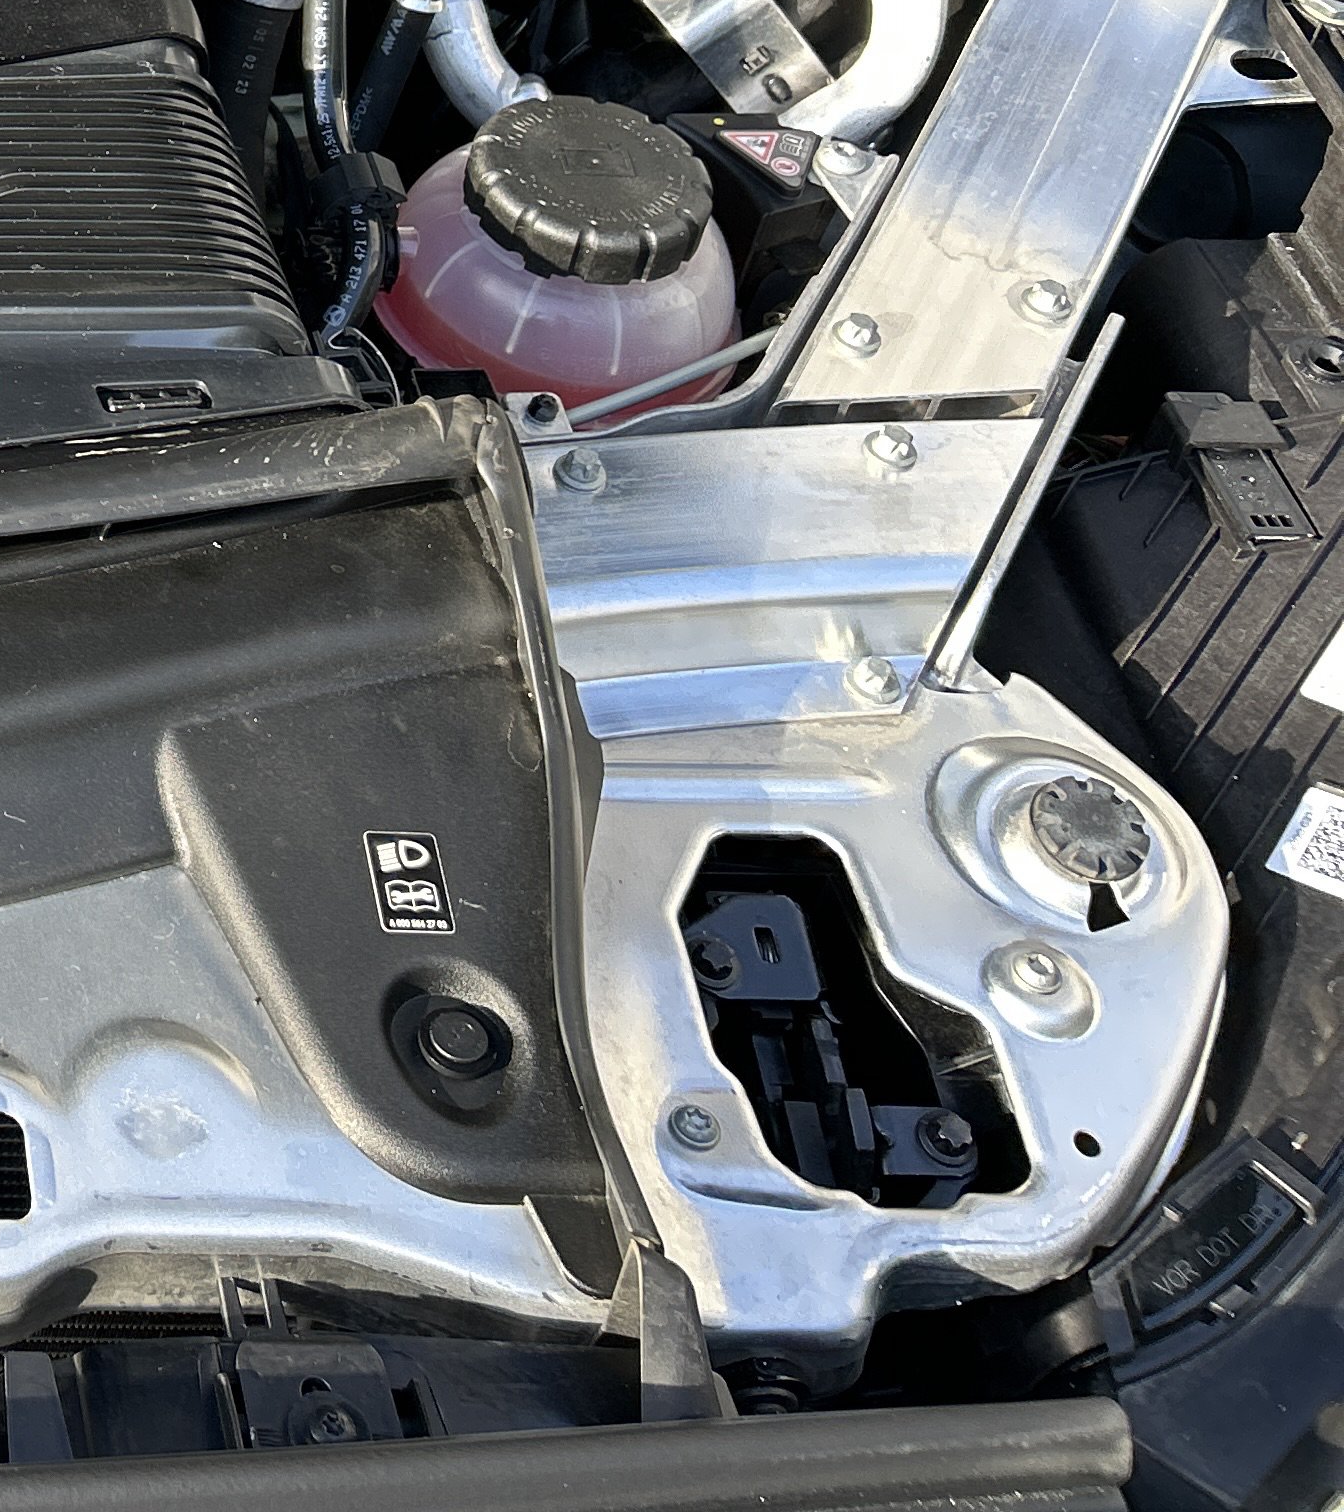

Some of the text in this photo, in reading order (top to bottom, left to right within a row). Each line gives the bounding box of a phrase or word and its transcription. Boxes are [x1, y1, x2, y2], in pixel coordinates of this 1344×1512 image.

[241, 54, 257, 70] 02
[234, 79, 249, 95] 23
[354, 218, 367, 234] 17
[354, 239, 368, 262] 471
[345, 270, 363, 291] 213
[1151, 1259, 1202, 1296] VOR
[1195, 1225, 1241, 1267] DOT
